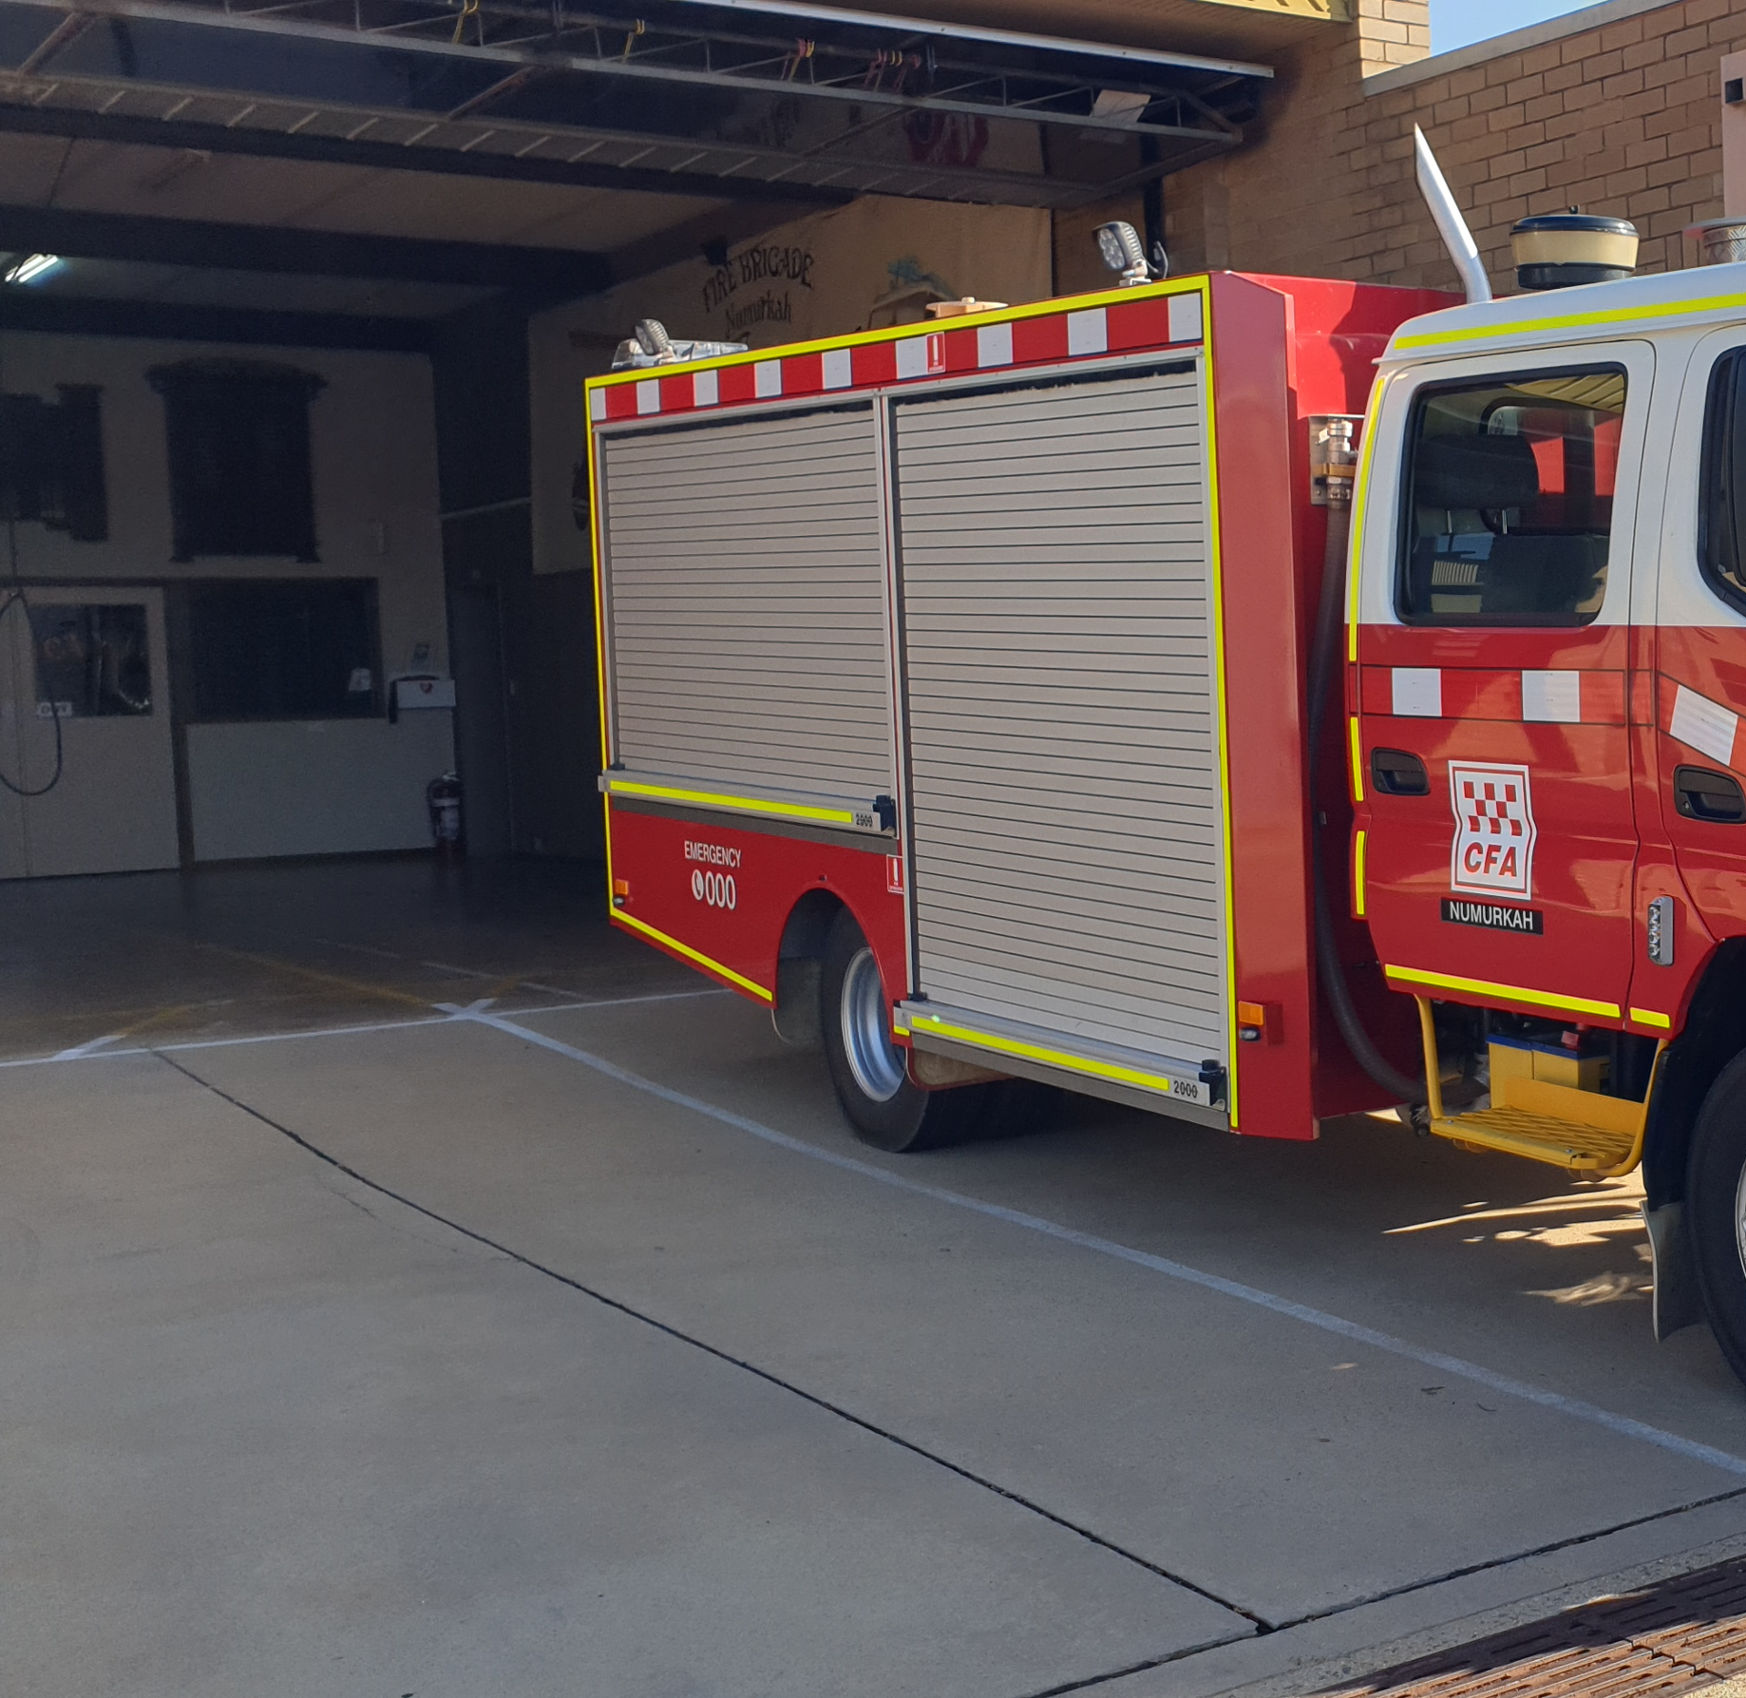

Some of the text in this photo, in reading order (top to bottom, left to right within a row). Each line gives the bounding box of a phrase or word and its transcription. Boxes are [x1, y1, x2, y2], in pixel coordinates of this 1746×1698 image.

[702, 247, 814, 312] FIRE BRIGADE
[684, 839, 742, 868] EMERGENCY
[1464, 842, 1517, 877] CFA
[705, 870, 737, 911] 000
[1449, 901, 1534, 930] NUMURKAH
[1173, 1080, 1198, 1099] 2000
